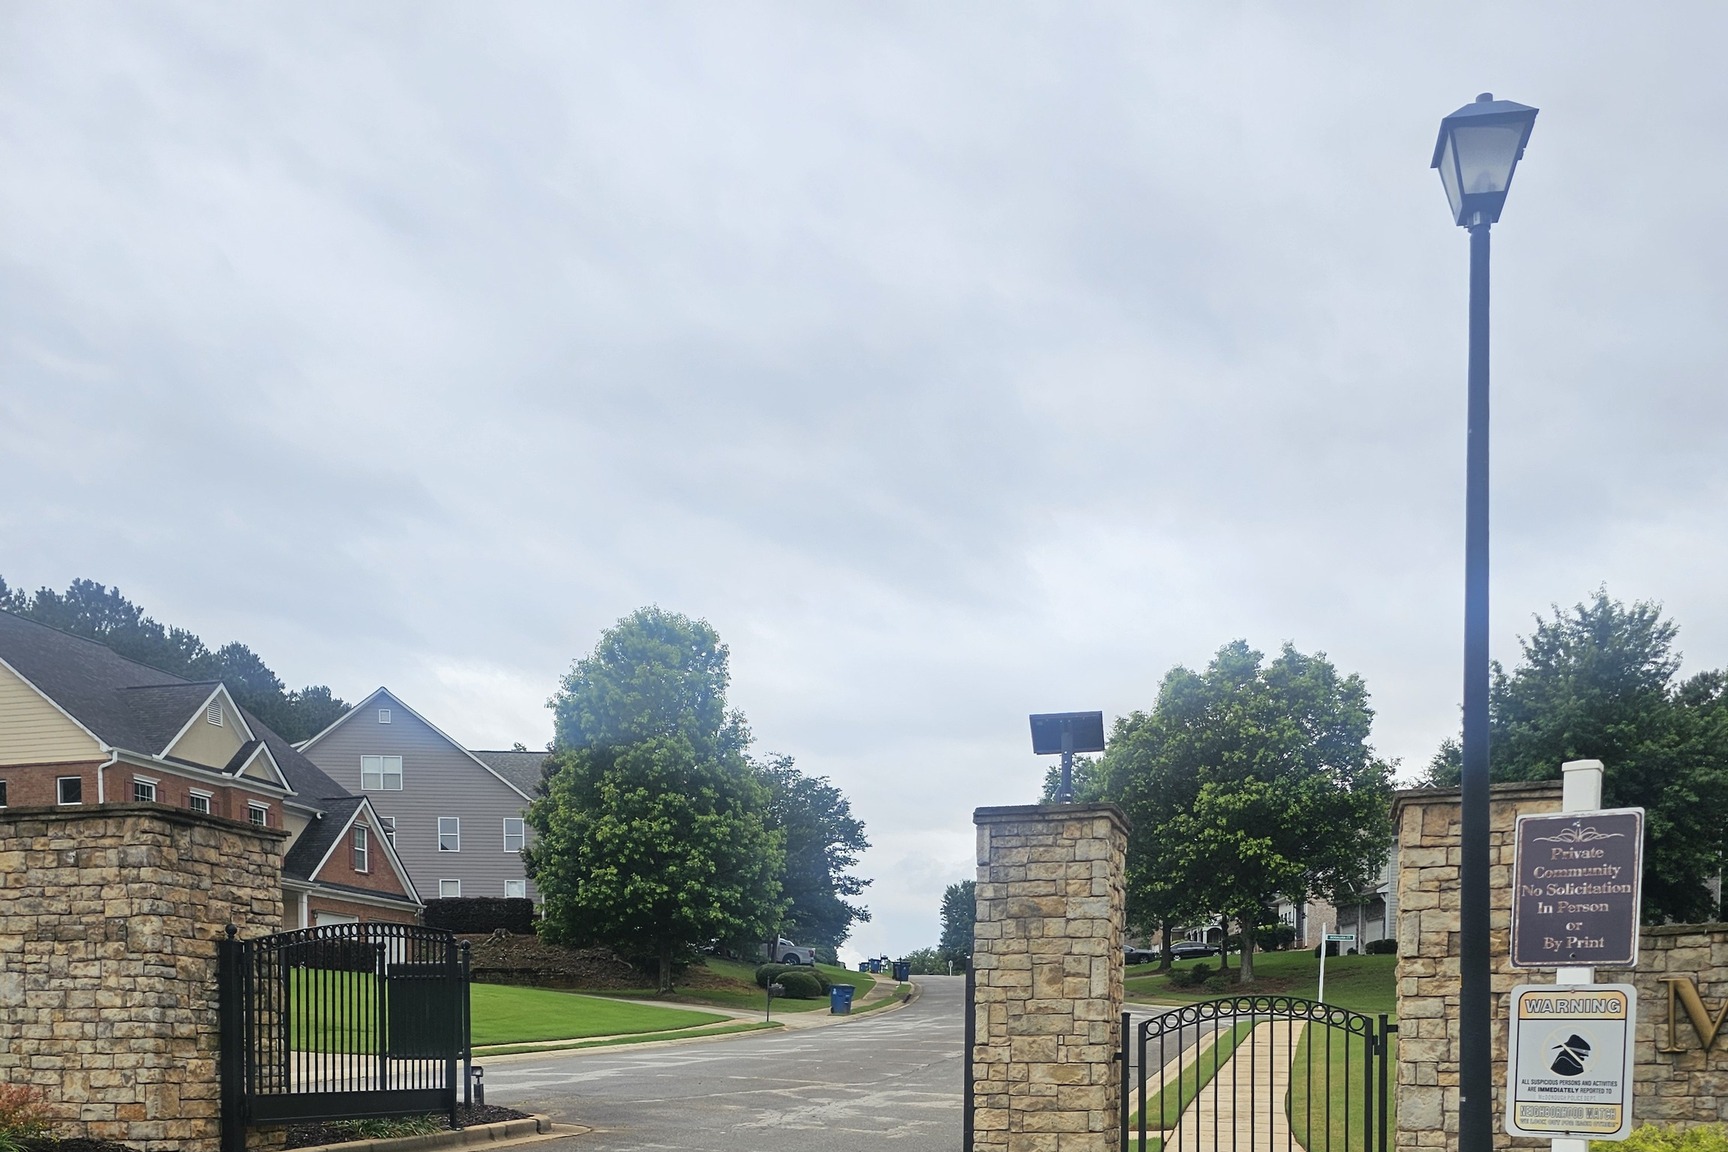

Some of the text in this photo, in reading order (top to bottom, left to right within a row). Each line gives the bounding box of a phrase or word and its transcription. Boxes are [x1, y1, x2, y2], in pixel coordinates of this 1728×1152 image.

[1551, 847, 1604, 861] Private
[1533, 864, 1621, 879] Community
[1522, 882, 1631, 897] No Solicitation
[1537, 901, 1609, 914] In Person
[1566, 921, 1583, 931] or
[1543, 936, 1604, 952] By Print
[1525, 998, 1622, 1014] WARNING
[1520, 1105, 1617, 1120] NEIGHBORHOOD WATCH
